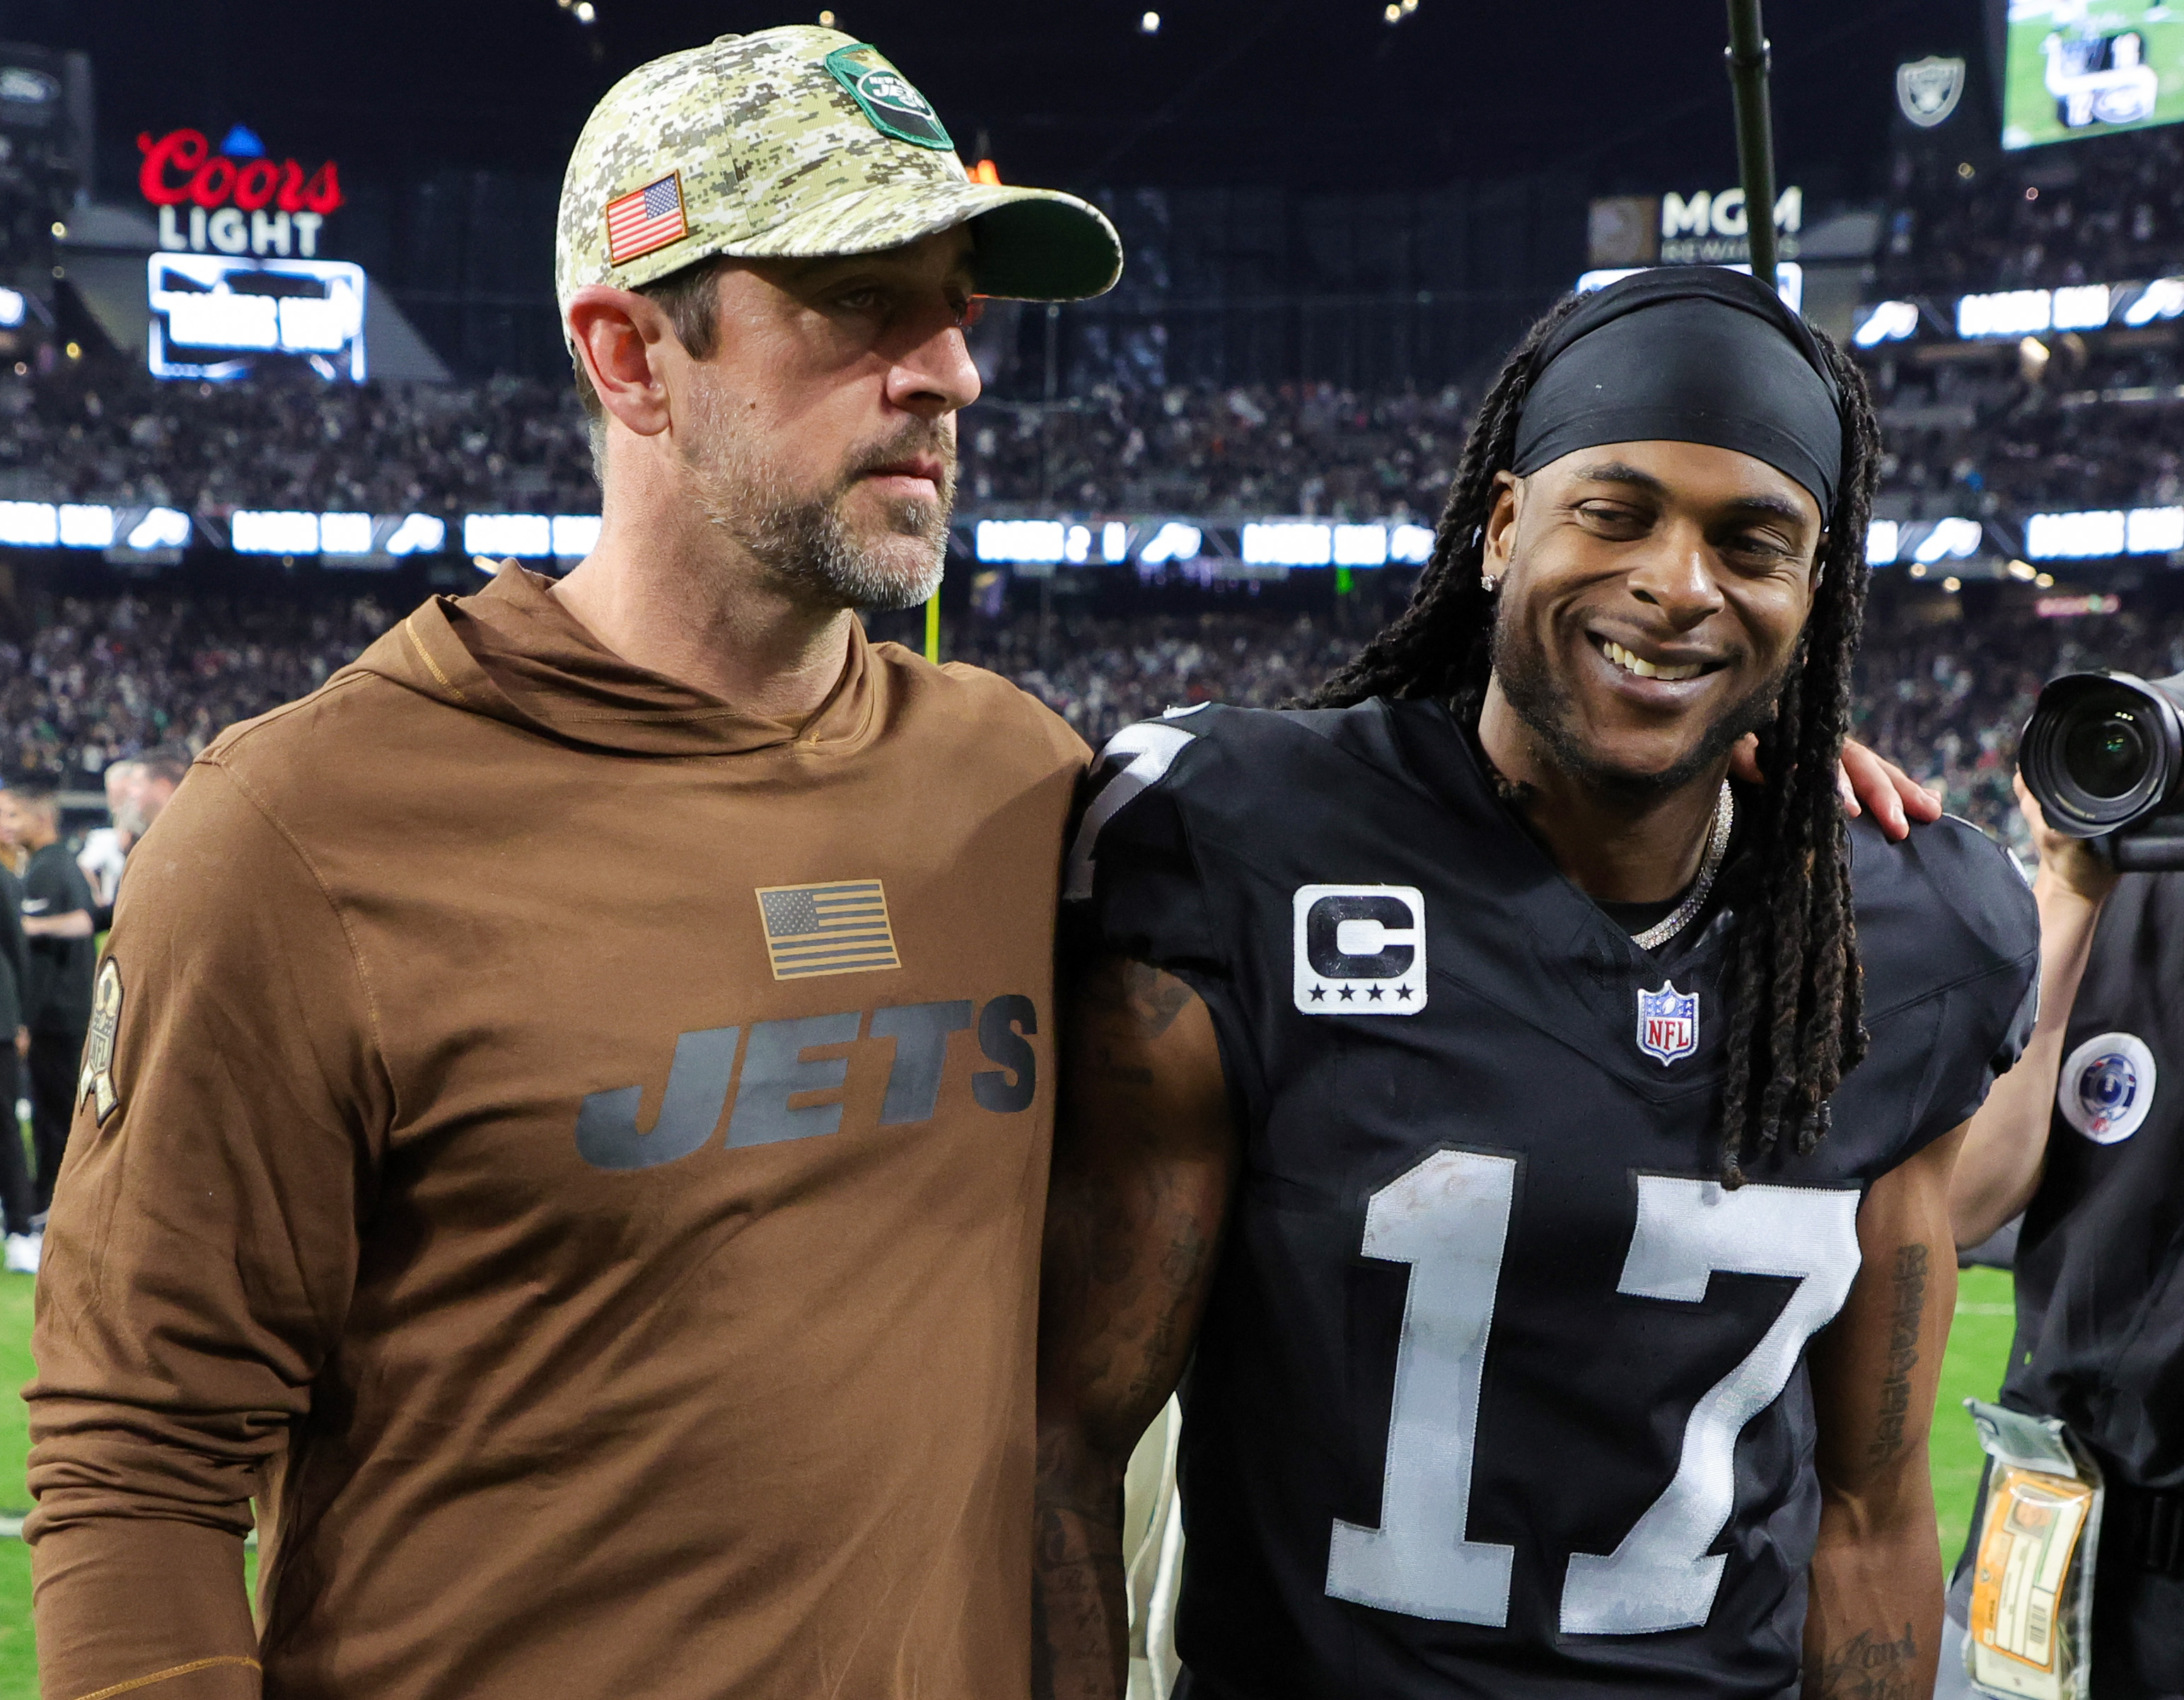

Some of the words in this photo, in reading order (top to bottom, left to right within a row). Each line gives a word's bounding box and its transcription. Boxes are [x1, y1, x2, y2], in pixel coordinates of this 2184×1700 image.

[869, 76, 895, 85] NEW
[136, 128, 346, 215] Coors
[158, 204, 323, 258] LIGHT
[1306, 895, 1415, 978] C
[1648, 1019, 1689, 1051] NFL
[574, 994, 1038, 1170] JETS
[1325, 1149, 1862, 1635] 17
